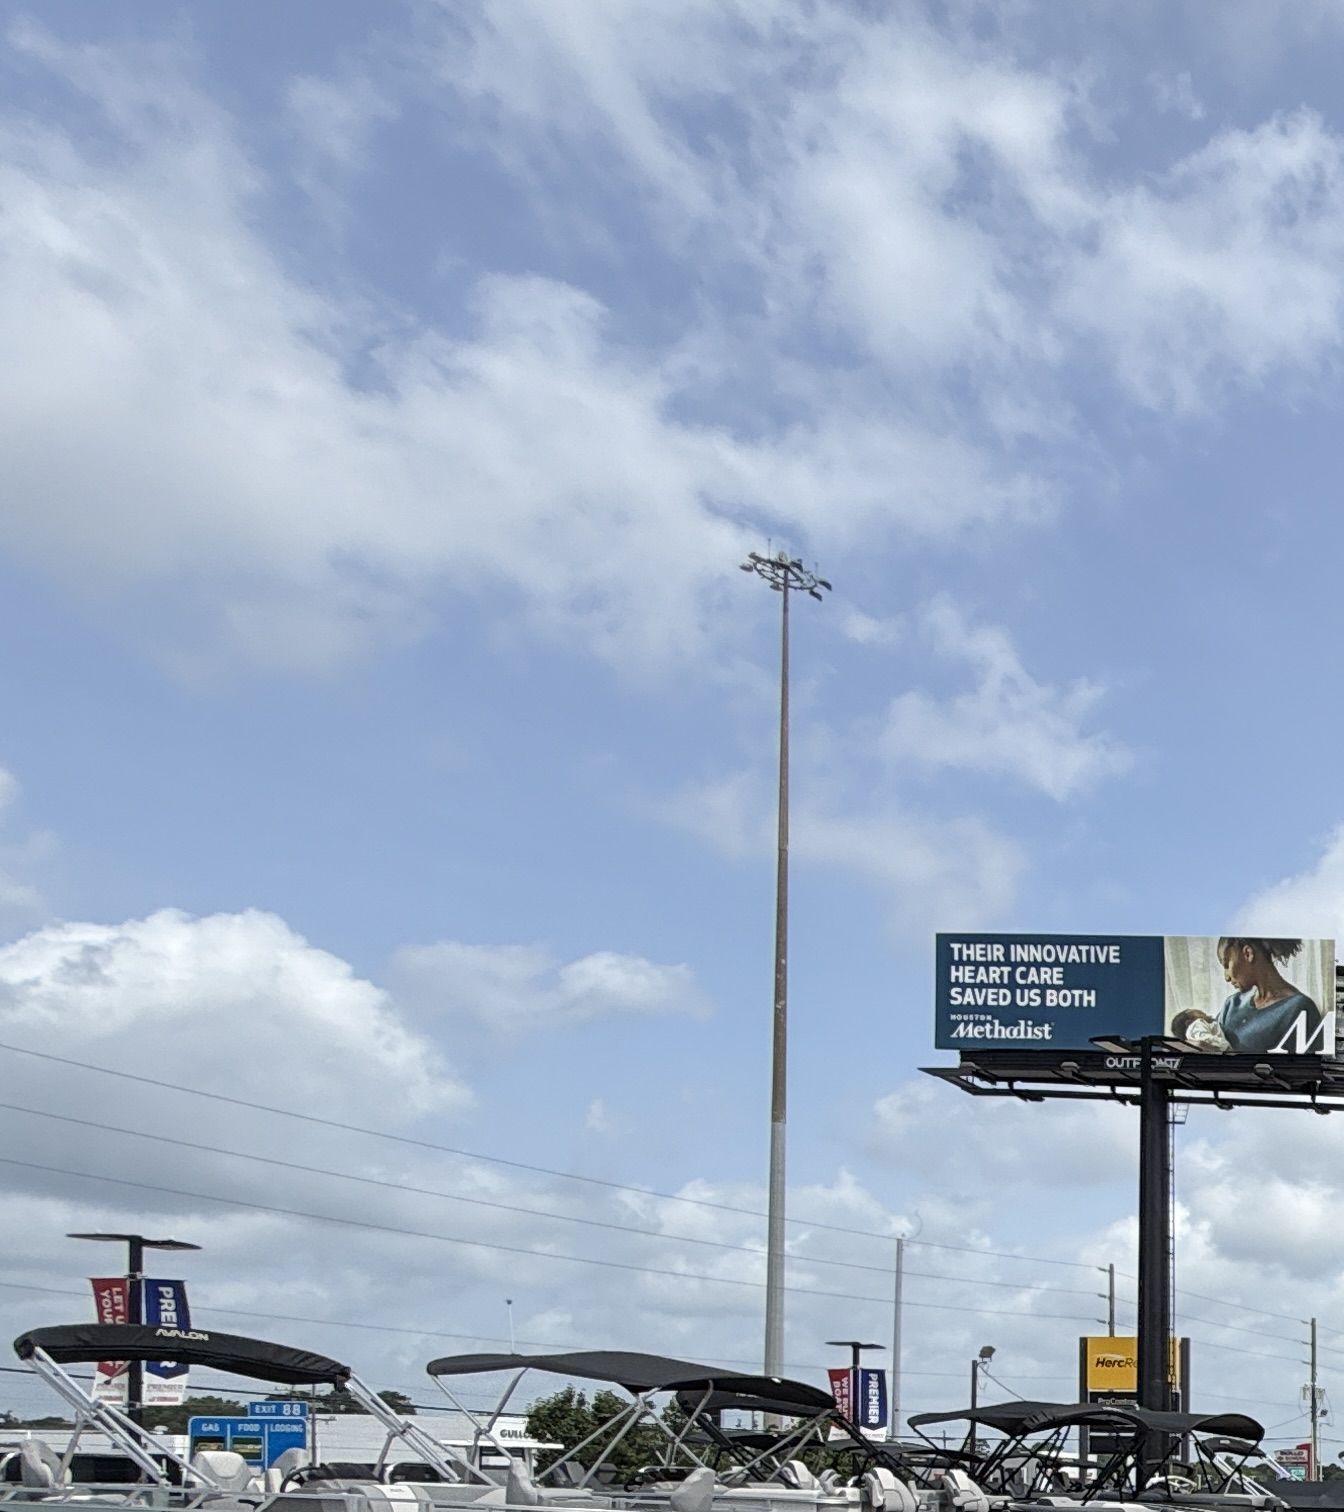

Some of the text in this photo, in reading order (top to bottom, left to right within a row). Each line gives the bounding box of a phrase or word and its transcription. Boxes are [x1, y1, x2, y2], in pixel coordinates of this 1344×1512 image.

[950, 943, 1121, 964] THEIR INNOVATIVE
[950, 965, 1064, 985] HEART CARE
[950, 987, 1096, 1008] SAVED US BOTH
[950, 1019, 1053, 1040] Methodist
[155, 1328, 209, 1341] AVALON
[869, 1373, 879, 1424] PREMIER
[201, 1423, 303, 1433] GAS FOOD LODGING
